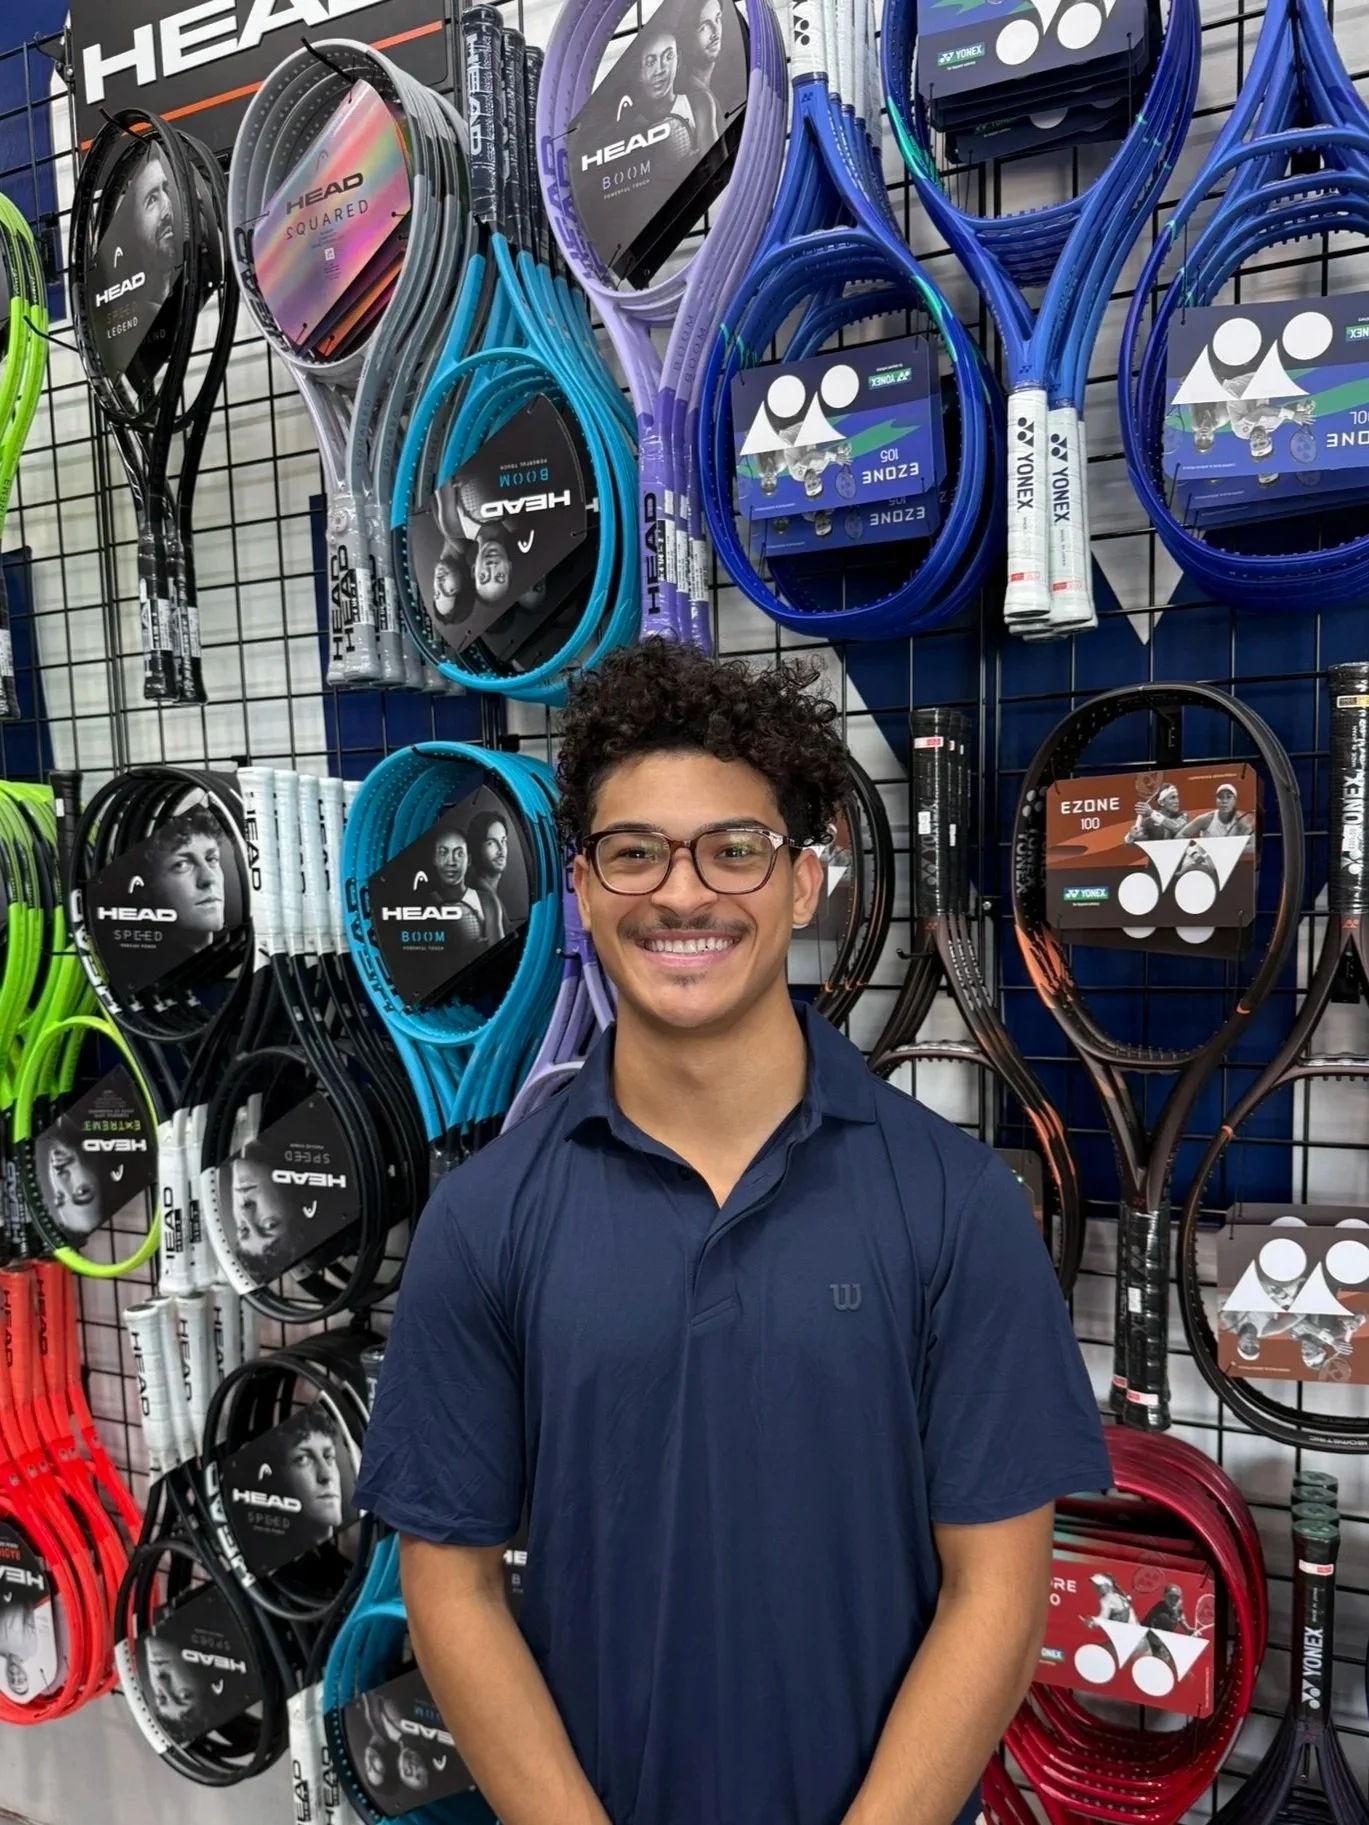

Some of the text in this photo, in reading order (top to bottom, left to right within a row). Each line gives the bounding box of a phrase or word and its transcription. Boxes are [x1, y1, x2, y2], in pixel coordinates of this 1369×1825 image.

[83, 0, 382, 104] HEA
[956, 44, 982, 60] YONEX
[467, 34, 482, 156] HEAD
[581, 122, 671, 172] HEAD
[602, 160, 651, 190] BOOM
[286, 173, 364, 215] HEAD
[285, 199, 369, 240] SQUARED
[95, 271, 146, 307] HEAD
[107, 316, 139, 339] LEGEND
[1349, 327, 1369, 339] NEX
[871, 375, 896, 388] YONEX
[1326, 430, 1369, 448] ONE
[880, 448, 899, 463] 105
[499, 467, 549, 488] BOOM
[862, 462, 919, 485] EZONE
[1016, 453, 1034, 511] YONEX
[480, 489, 571, 519] HEAD
[1052, 467, 1070, 523] YONEX
[870, 506, 926, 526] EZONE
[644, 493, 660, 615] HEAD
[331, 555, 344, 661] HEAD
[339, 545, 355, 653] HEAD
[1061, 797, 1120, 815] EZONE
[1080, 817, 1100, 831] 100
[1081, 889, 1106, 899] YONEX
[97, 907, 178, 922] HEAD
[382, 906, 462, 921] HEAD
[113, 930, 163, 942] SPEED
[401, 931, 445, 943] BOOM
[84, 1120, 141, 1131] EXTREME
[82, 1138, 148, 1152] HEAD
[284, 1151, 330, 1164] SPEED
[271, 1169, 346, 1189] HEAD
[3, 1290, 13, 1368] HEAD
[38, 1279, 48, 1356] HEAD
[177, 1319, 192, 1401] HEAD
[131, 1332, 150, 1417] HEAD
[232, 1488, 302, 1513] HEAD
[247, 1512, 290, 1529] SPEED
[0, 1565, 44, 1590] HE
[181, 1648, 247, 1674] HEAD
[1041, 1648, 1064, 1660] ONEX
[1303, 1626, 1324, 1678] YONEX
[400, 1719, 455, 1747] EAD
[293, 1760, 308, 1825] EAD
